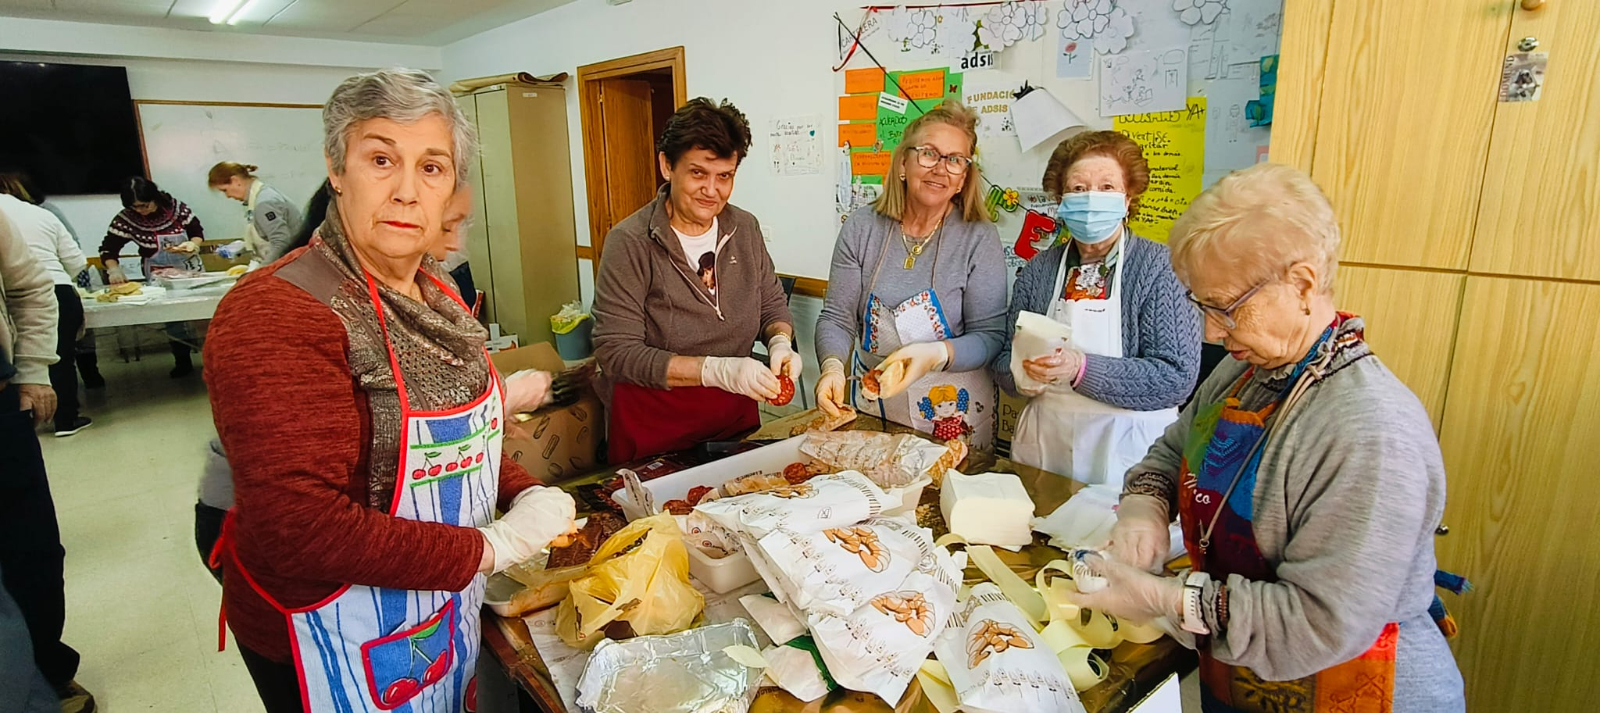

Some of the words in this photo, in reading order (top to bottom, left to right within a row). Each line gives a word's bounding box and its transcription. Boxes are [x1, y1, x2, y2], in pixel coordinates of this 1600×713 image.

[967, 89, 1015, 104] FUNDACIÓ
[981, 104, 1008, 114] ADSIS
[1002, 404, 1018, 419] Pa
[1002, 419, 1015, 433] Ba
